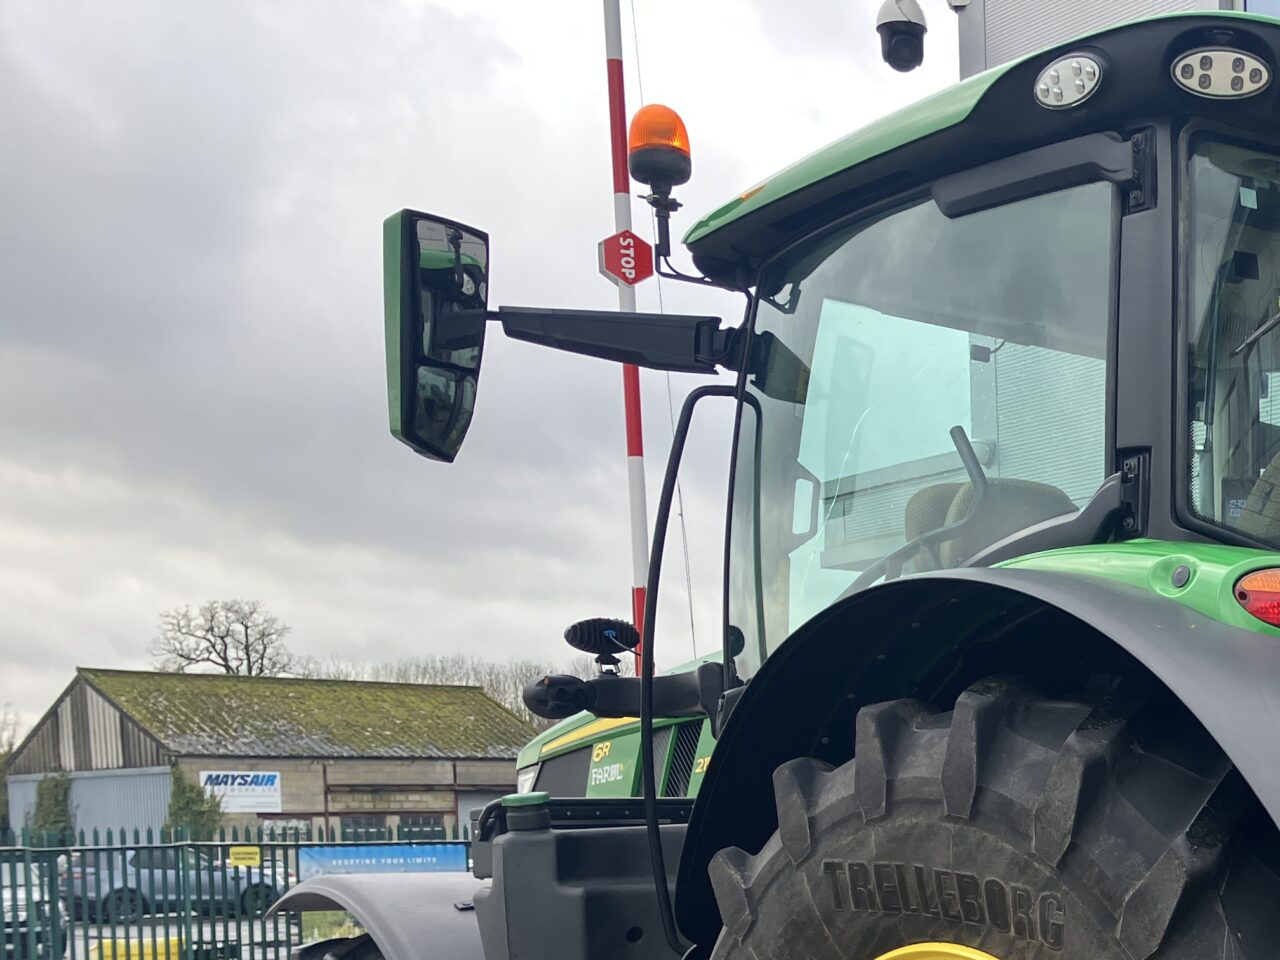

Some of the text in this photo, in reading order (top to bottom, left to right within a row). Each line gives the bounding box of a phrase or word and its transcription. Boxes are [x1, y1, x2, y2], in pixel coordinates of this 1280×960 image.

[620, 237, 636, 279] STOP
[593, 741, 611, 762] 6R
[203, 774, 278, 786] MAYSAIR
[591, 763, 623, 785] FAROL
[822, 858, 1067, 950] TRELLEBORG
